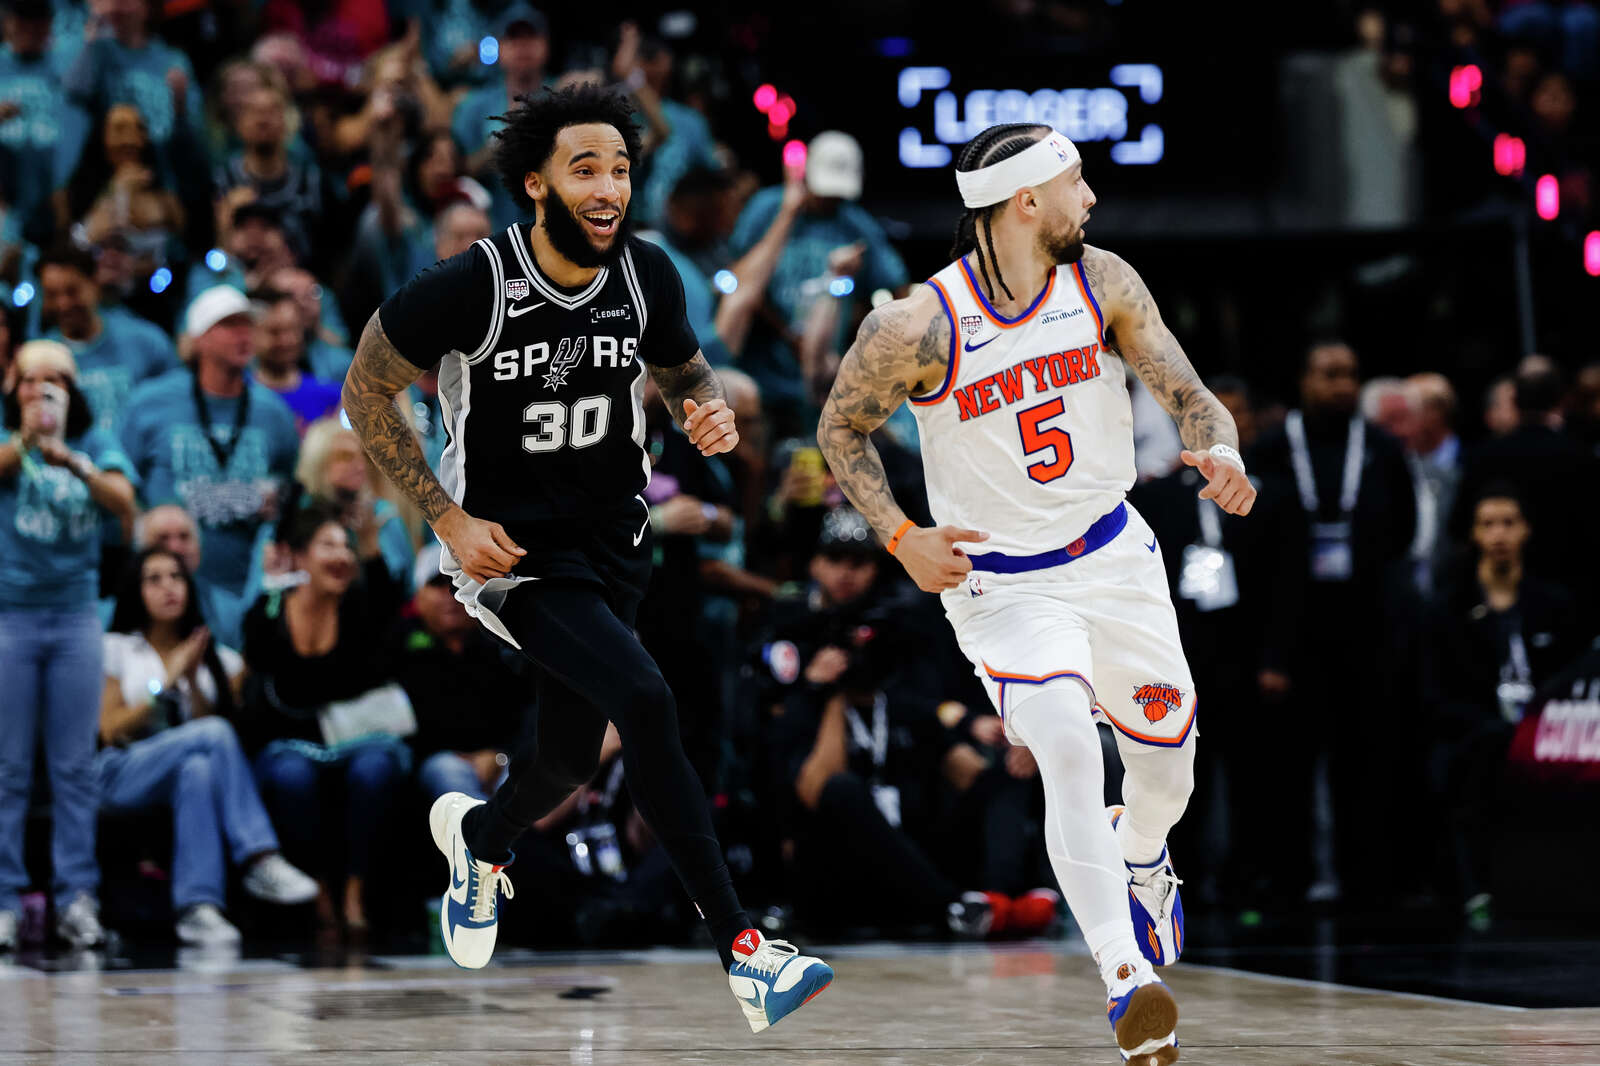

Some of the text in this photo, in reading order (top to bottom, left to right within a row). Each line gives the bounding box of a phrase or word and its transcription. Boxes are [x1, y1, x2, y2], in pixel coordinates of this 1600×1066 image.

[934, 88, 1128, 143] LEDGER
[596, 309, 626, 319] LEDGER
[493, 335, 638, 392] SPURS
[953, 343, 1101, 422] NEW YORK
[521, 394, 612, 454] 30
[1015, 395, 1075, 485] 5
[1132, 685, 1182, 708] KNICKS
